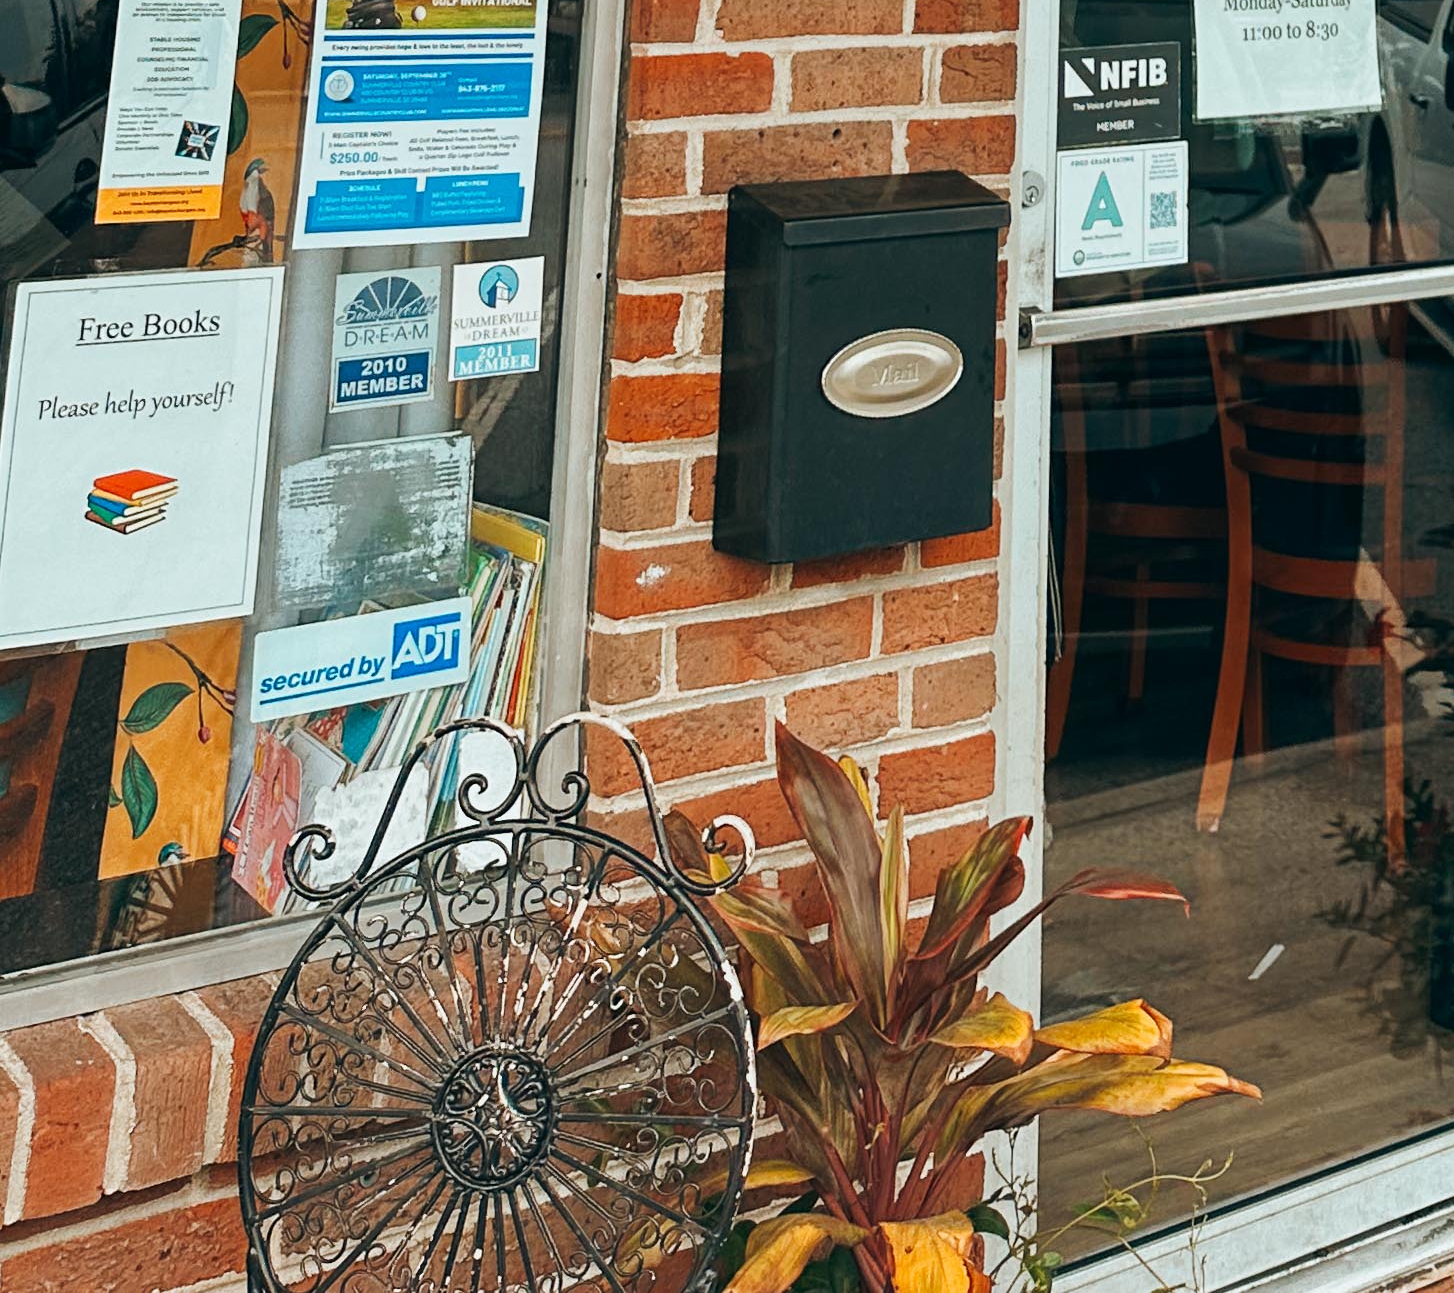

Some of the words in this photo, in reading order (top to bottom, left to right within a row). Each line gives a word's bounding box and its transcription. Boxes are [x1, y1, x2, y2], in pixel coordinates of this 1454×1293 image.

[1243, 26, 1282, 42] 11:00
[1287, 22, 1301, 39] to
[1306, 20, 1339, 41] 8:30
[1101, 57, 1168, 91] NFIB
[1073, 102, 1085, 111] The
[1086, 102, 1104, 110] Voice
[1105, 100, 1112, 109] of
[1132, 97, 1160, 107] Business
[1096, 119, 1135, 132] MEMBER
[330, 152, 378, 164] $250.00
[1081, 170, 1124, 230] A
[77, 317, 134, 342] Free
[143, 310, 221, 337] Books
[454, 310, 539, 329] SUMMERVILLE
[472, 326, 520, 341] DREAM
[478, 342, 513, 360] 2011
[360, 356, 407, 377] 2010
[458, 353, 531, 376] MEMBER
[872, 362, 919, 386] Mail
[340, 374, 424, 398] MEMBER
[38, 397, 100, 420] Please
[104, 389, 147, 419] help
[149, 381, 235, 418] yourself!
[259, 656, 355, 696] secured
[358, 653, 386, 678] by
[392, 623, 459, 669] ADT
